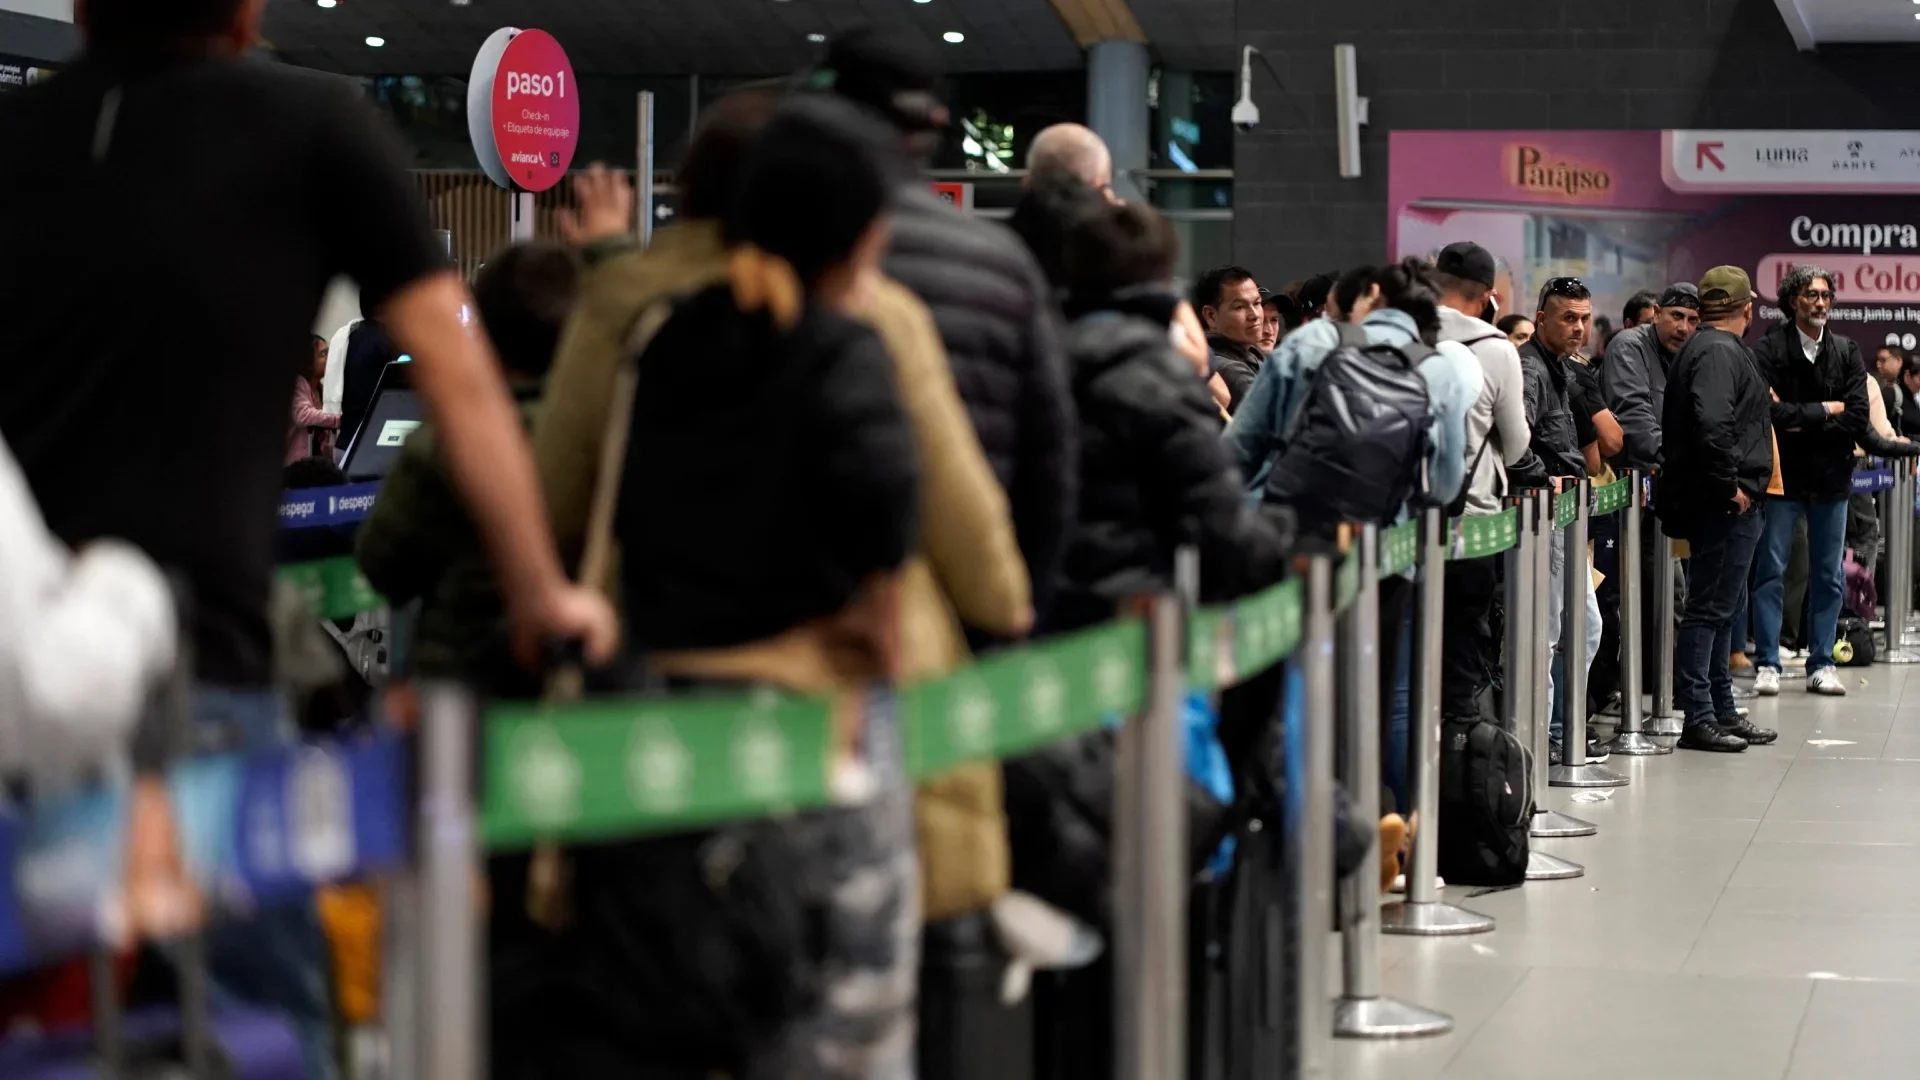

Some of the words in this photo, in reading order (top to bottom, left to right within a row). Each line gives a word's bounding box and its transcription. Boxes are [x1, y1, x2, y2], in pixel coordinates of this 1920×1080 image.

[507, 71, 554, 100] paso
[557, 70, 565, 98] 1
[522, 108, 549, 121] Check-in
[507, 121, 533, 136] Etiqueta
[534, 125, 542, 135] de
[543, 126, 570, 139] equipaje
[1790, 215, 1918, 256] Compra
[1863, 306, 1893, 323] junto
[1894, 306, 1905, 321] al
